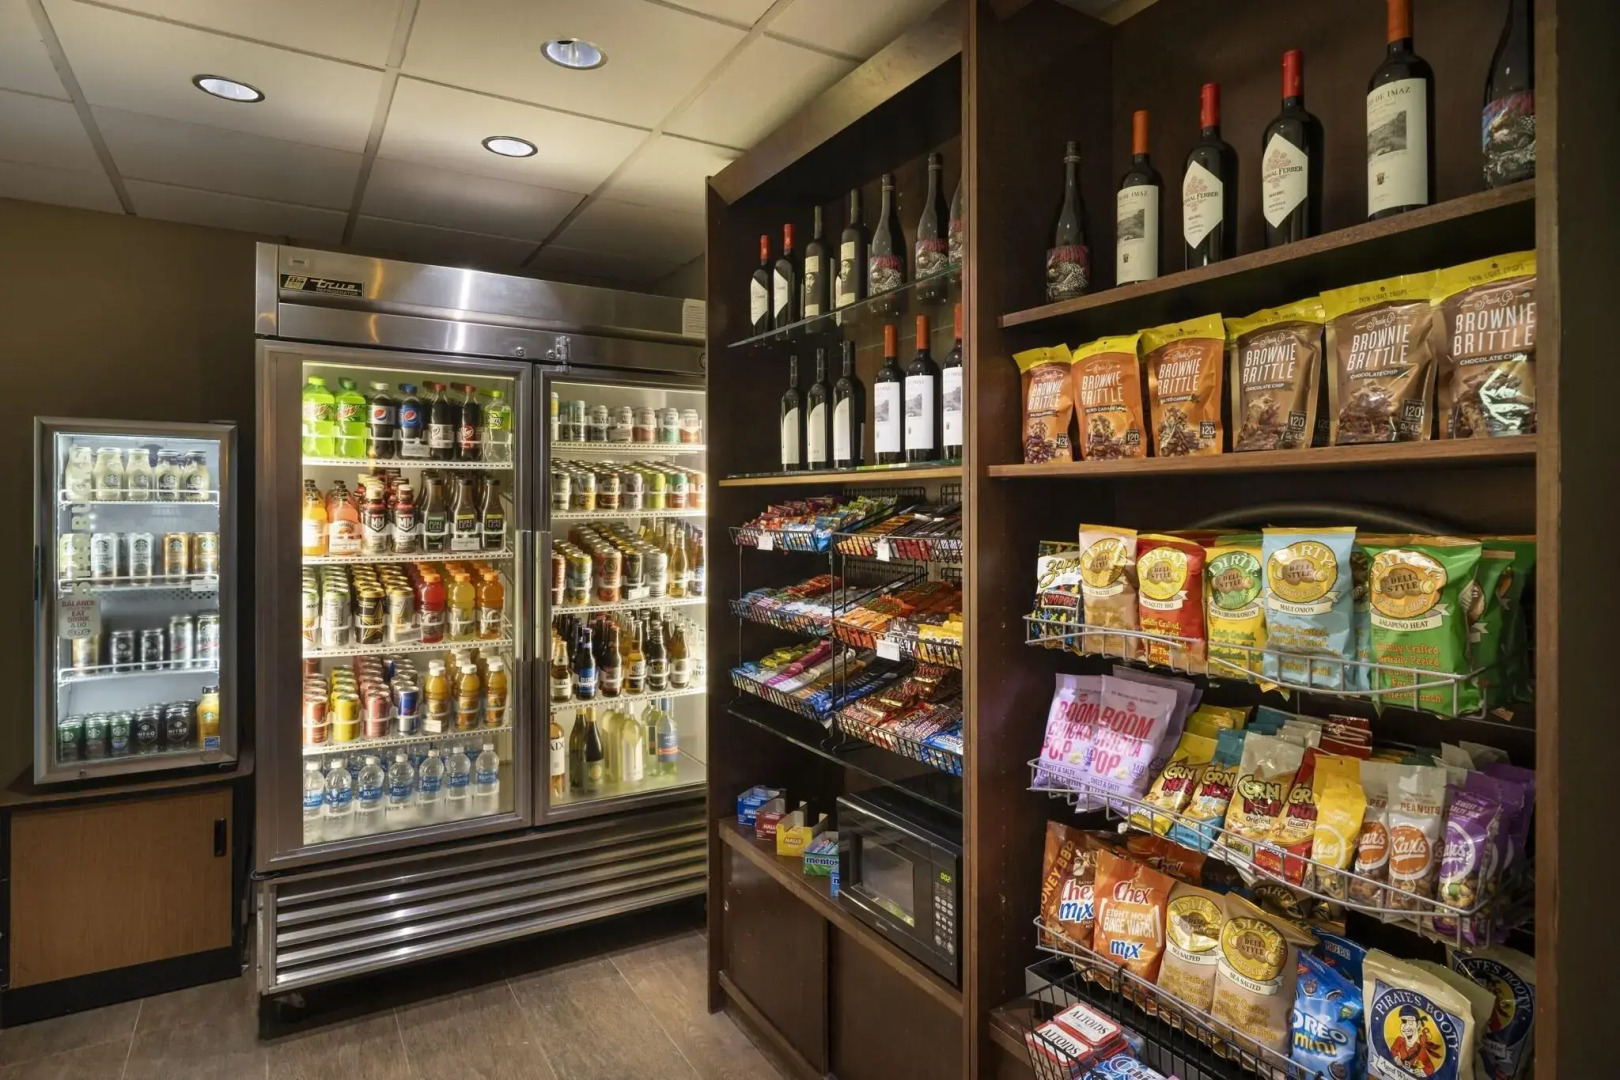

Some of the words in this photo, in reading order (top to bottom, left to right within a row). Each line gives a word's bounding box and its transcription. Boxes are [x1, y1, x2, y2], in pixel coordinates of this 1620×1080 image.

[1387, 86, 1411, 98] IMAZ
[1278, 165, 1304, 175] FERRER
[1196, 191, 1220, 200] FERRER
[311, 279, 359, 292] true
[1455, 302, 1537, 335] BROWNIE
[1351, 323, 1412, 353] BROWNIE
[1453, 325, 1535, 357] BRITTLE
[1245, 343, 1297, 367] BROWNIE
[1346, 344, 1409, 372] BRITTLE
[1460, 355, 1503, 366] CHOCOLATE
[1158, 357, 1203, 379] BROWNIE
[1242, 361, 1297, 385] BRITTLE
[1350, 370, 1383, 380] CHOCOLATE
[1382, 369, 1399, 377] CHIP
[1033, 379, 1065, 397] BROWNIE
[1082, 370, 1123, 391] BROWNIE
[1157, 374, 1200, 396] BRITTLE
[1245, 383, 1272, 392] CHOCOLATE
[1028, 393, 1062, 411] BRITTLE
[1081, 386, 1124, 406] BRITTLE
[1404, 405, 1422, 418] 120
[1201, 425, 1215, 435] 120
[1290, 416, 1305, 428] 120
[1126, 432, 1140, 444] 120
[1208, 553, 1260, 575] DIRTY
[1275, 544, 1336, 569] IRTY
[1287, 571, 1313, 579] STYLE
[1289, 563, 1311, 572] DELI
[1387, 581, 1419, 593] STYLE
[1390, 574, 1414, 585] DELI
[1279, 603, 1295, 612] MALT
[1294, 605, 1315, 613] ONION
[1409, 620, 1429, 630] HEAT
[1056, 700, 1101, 725] BOOM
[1101, 706, 1155, 740] BOOM
[137, 730, 156, 738] NITRO
[1092, 746, 1122, 776] POP
[1132, 763, 1145, 775] 140
[1162, 761, 1196, 780] CORN
[1202, 765, 1237, 788] CORN
[1237, 774, 1282, 802] CORN
[1287, 783, 1314, 805] COR
[1369, 798, 1388, 809] PEA
[1401, 801, 1441, 816] PEANUTS
[784, 836, 803, 844] HALLS
[1057, 839, 1075, 869] BBQ
[1112, 880, 1155, 906] Chex
[1105, 907, 1129, 920] EIGHT
[1103, 916, 1126, 935] BINGE
[1126, 918, 1155, 939] WATCH
[1230, 918, 1286, 949] DIRTY
[1110, 939, 1145, 960] mix
[1241, 945, 1265, 956] STYLE
[1244, 937, 1265, 948] DELI
[1180, 952, 1201, 963] SALTED
[1229, 971, 1241, 983] SEA
[1240, 976, 1262, 993] SALTED
[1503, 971, 1532, 1014] BOOTY
[1069, 1009, 1111, 1035] ALTOIDS
[1375, 990, 1423, 1016] PIRATE'S
[1425, 1002, 1459, 1052] BOOTY
[1041, 1027, 1080, 1057] ALTOIDS
[1294, 1030, 1338, 1058] mini
[1380, 1060, 1397, 1077] Aged
